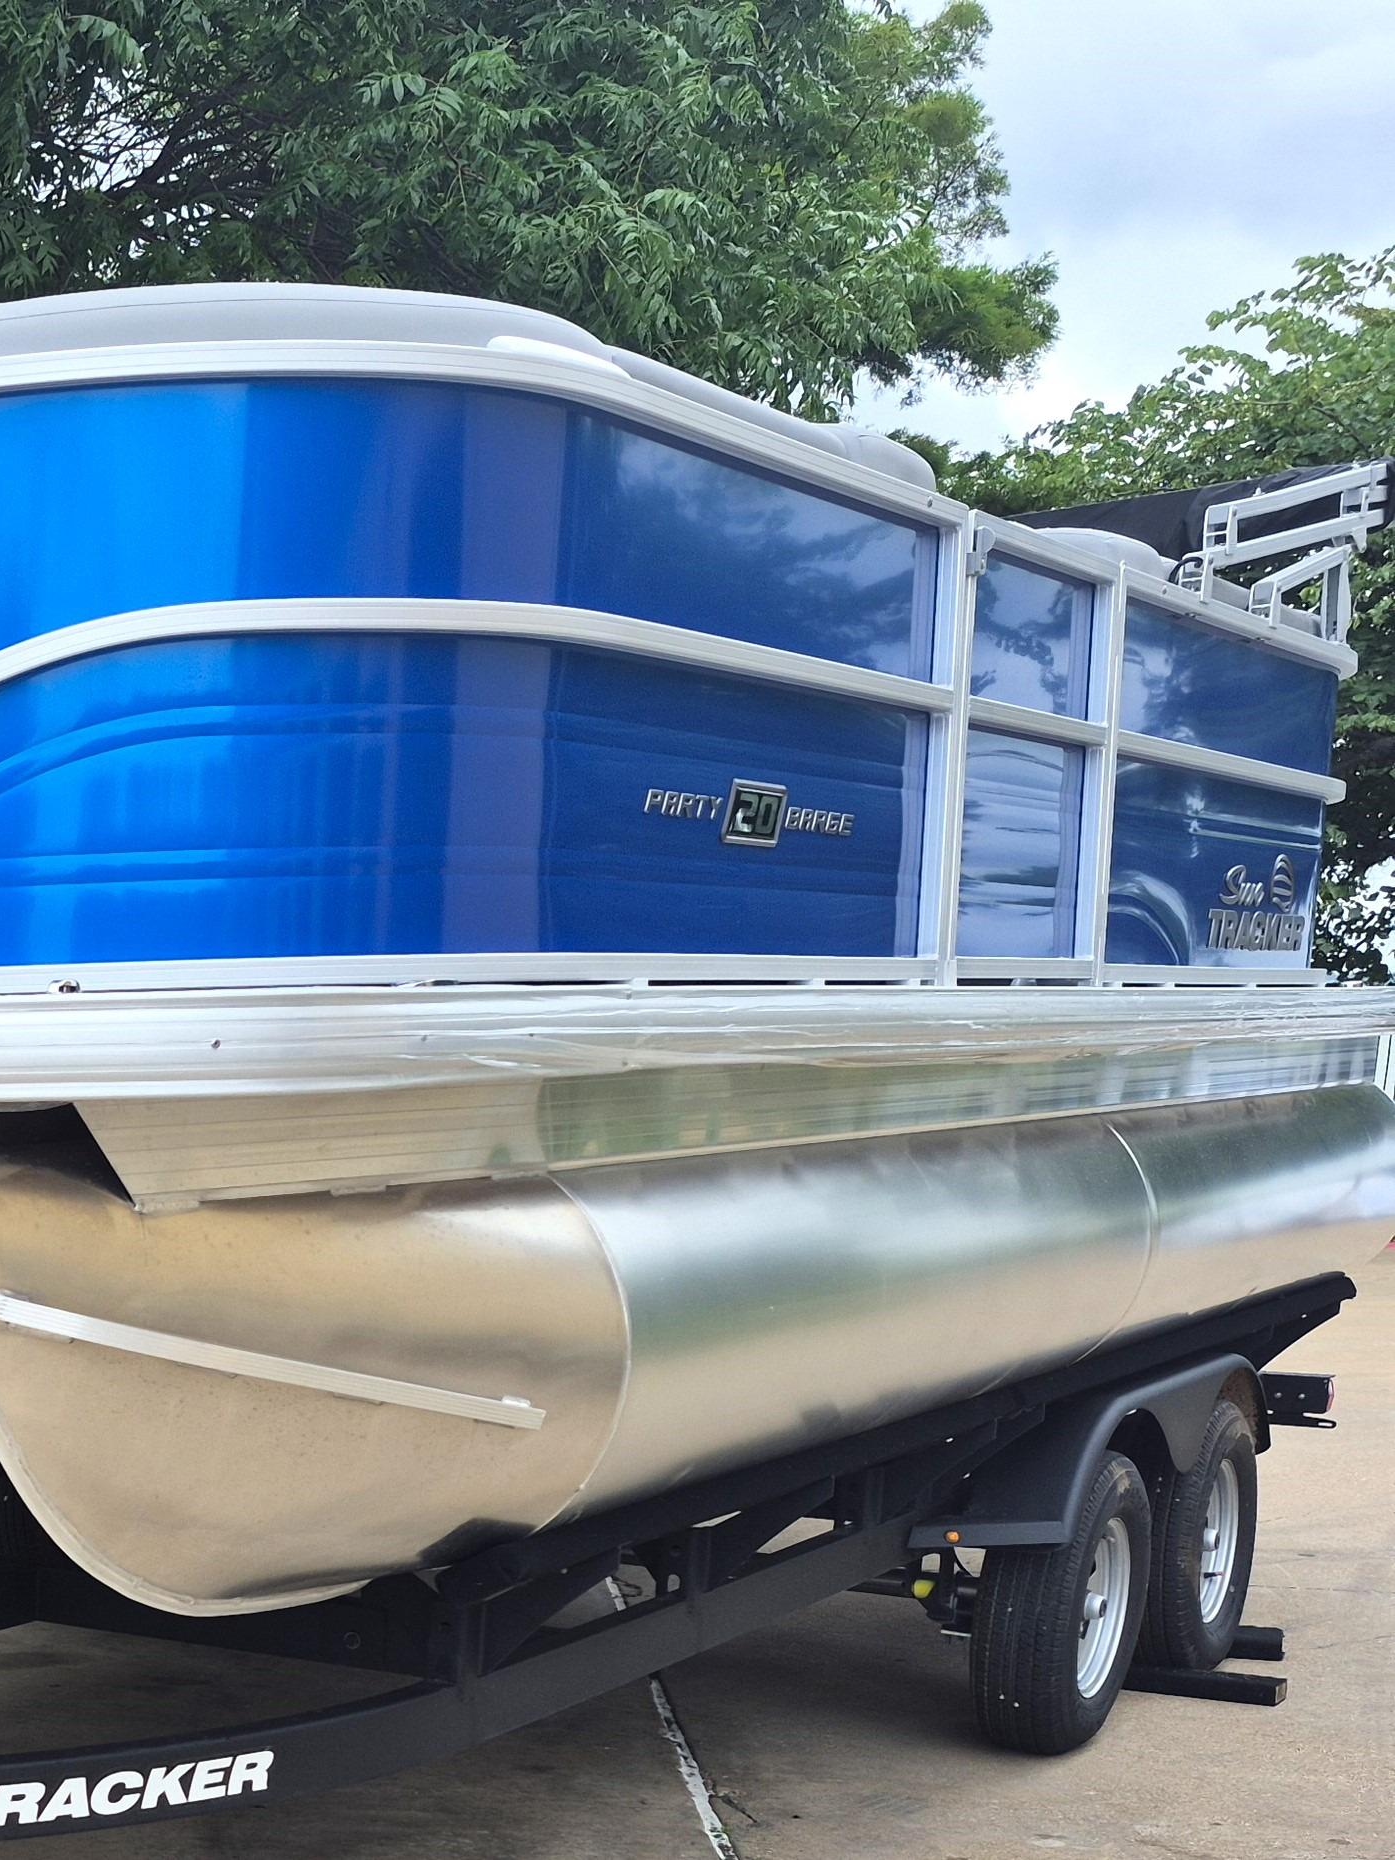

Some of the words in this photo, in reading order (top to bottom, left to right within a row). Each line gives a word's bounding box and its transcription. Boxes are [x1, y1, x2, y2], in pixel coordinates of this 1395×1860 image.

[643, 788, 723, 820] PARTY
[734, 793, 780, 835] 20
[784, 806, 855, 836] BARGE
[1219, 864, 1265, 906] Sun
[1207, 908, 1306, 952] TRACKER
